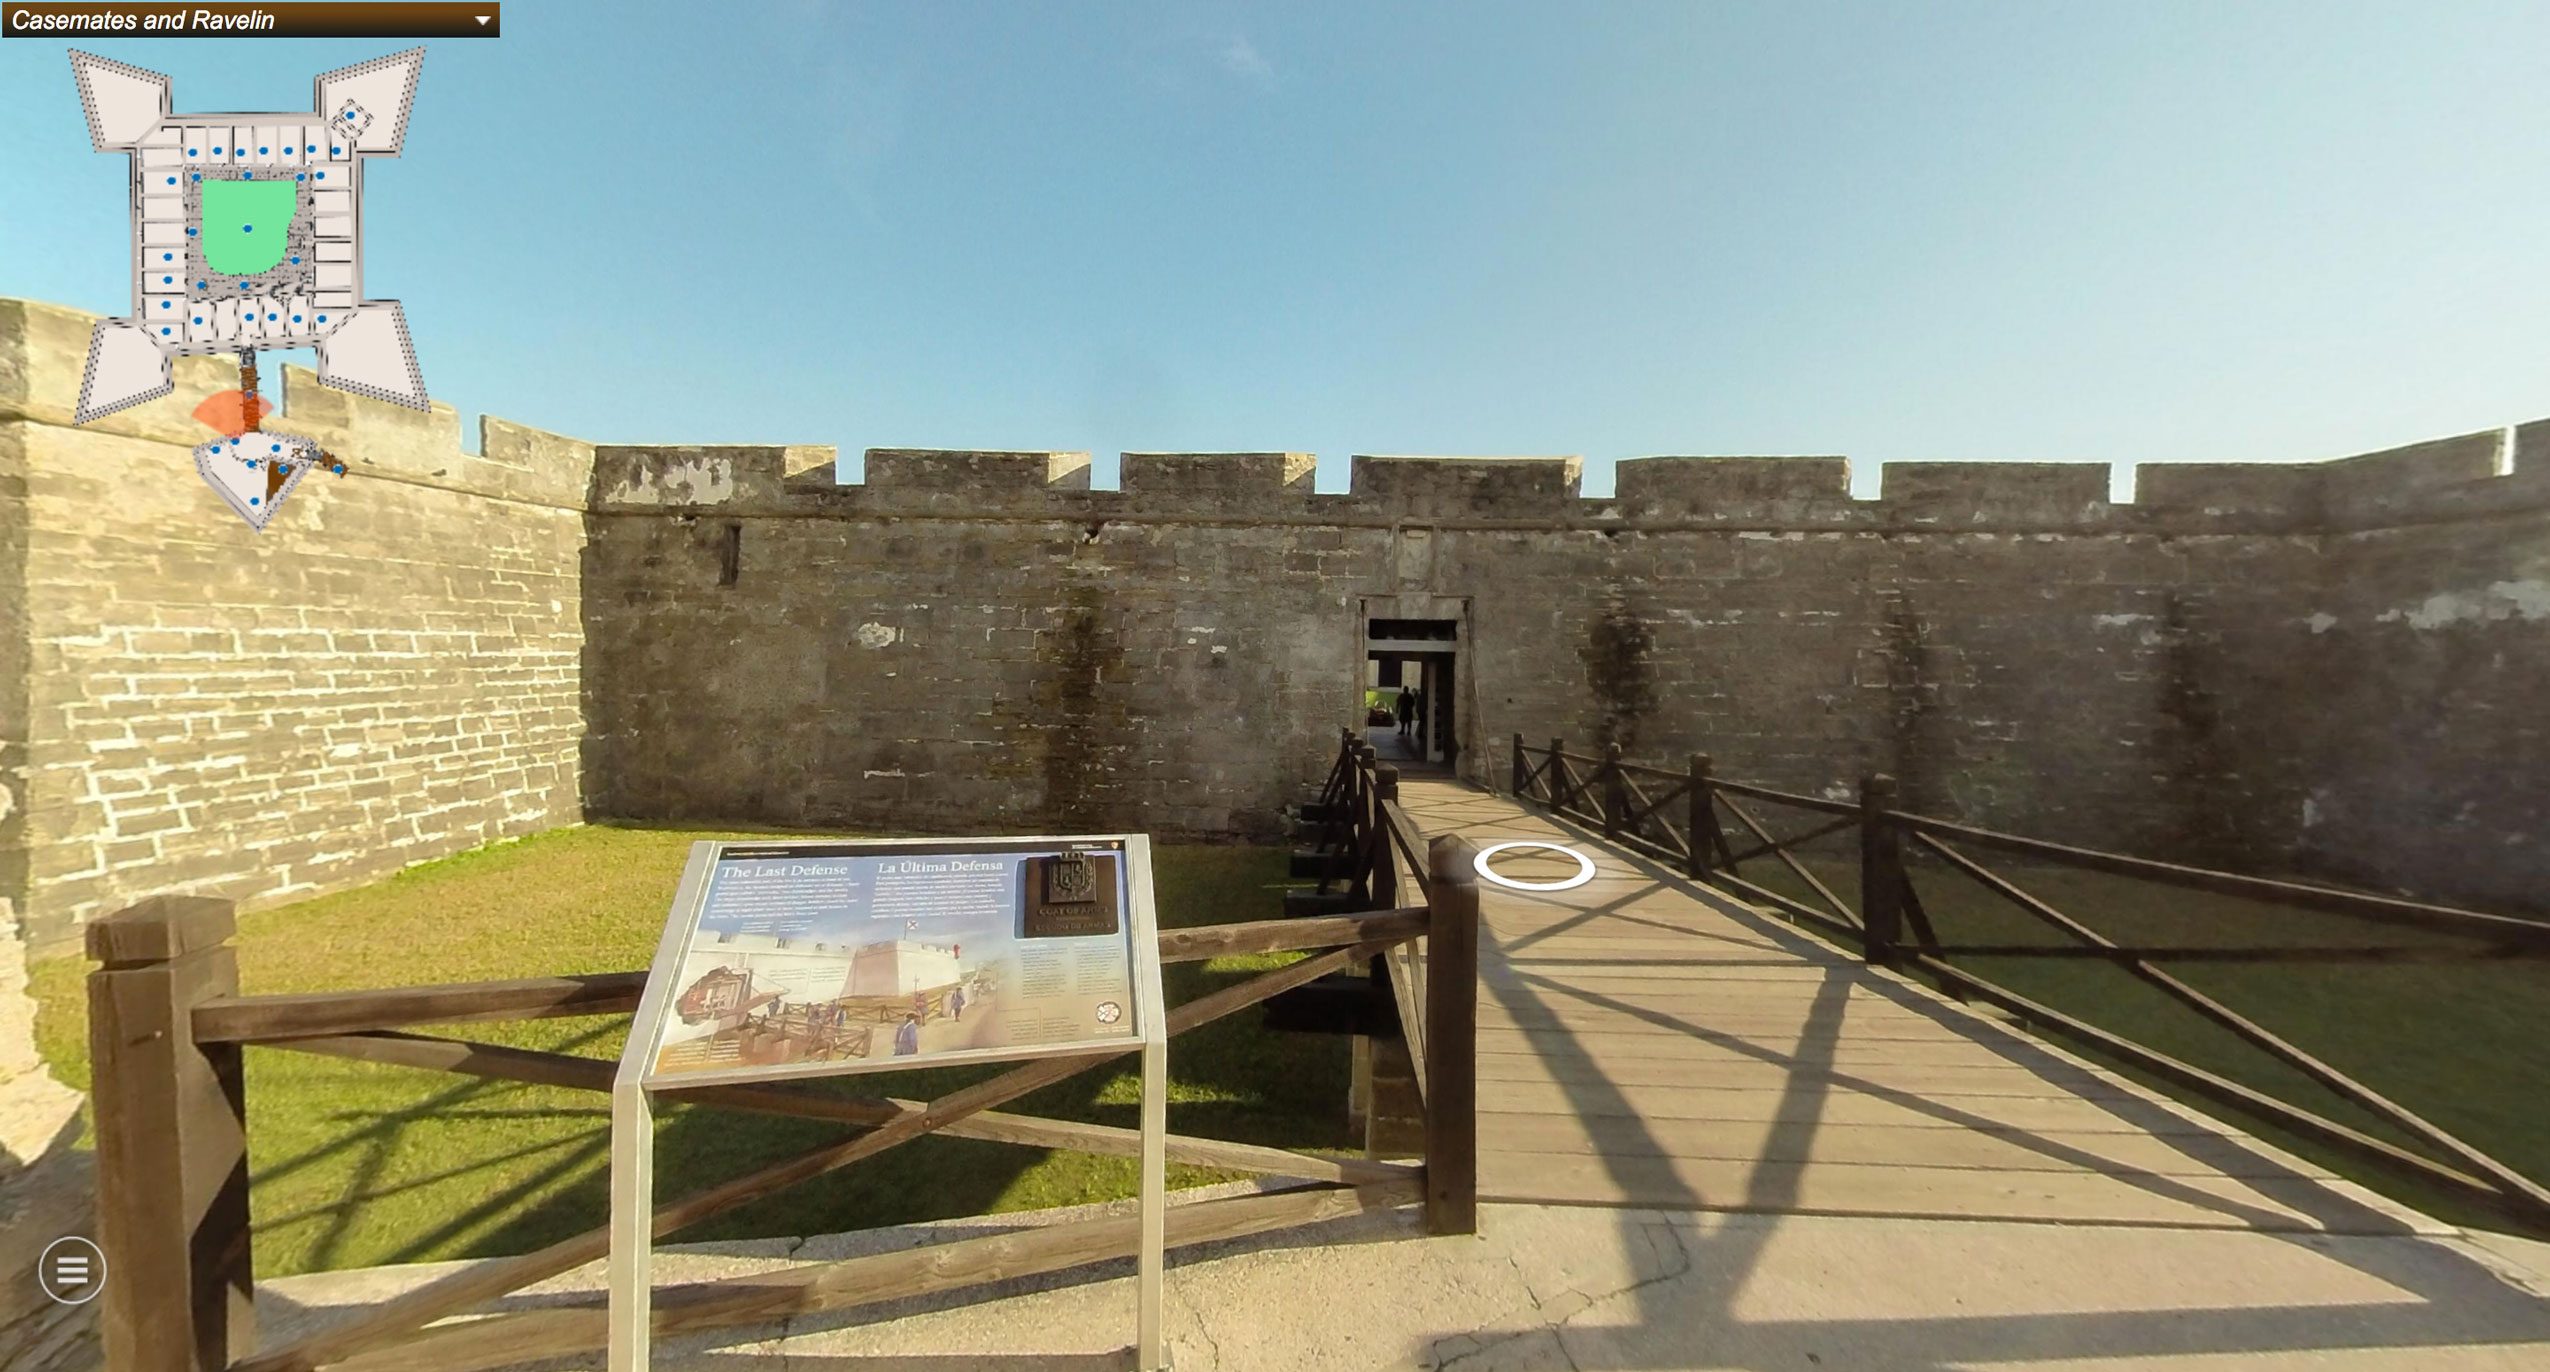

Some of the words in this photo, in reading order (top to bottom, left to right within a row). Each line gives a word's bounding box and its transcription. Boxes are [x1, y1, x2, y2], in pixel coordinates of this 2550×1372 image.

[722, 866, 751, 878] The
[755, 865, 786, 877] Last
[791, 864, 848, 876] Defense
[878, 862, 896, 873] La
[951, 860, 1003, 872] Defensa
